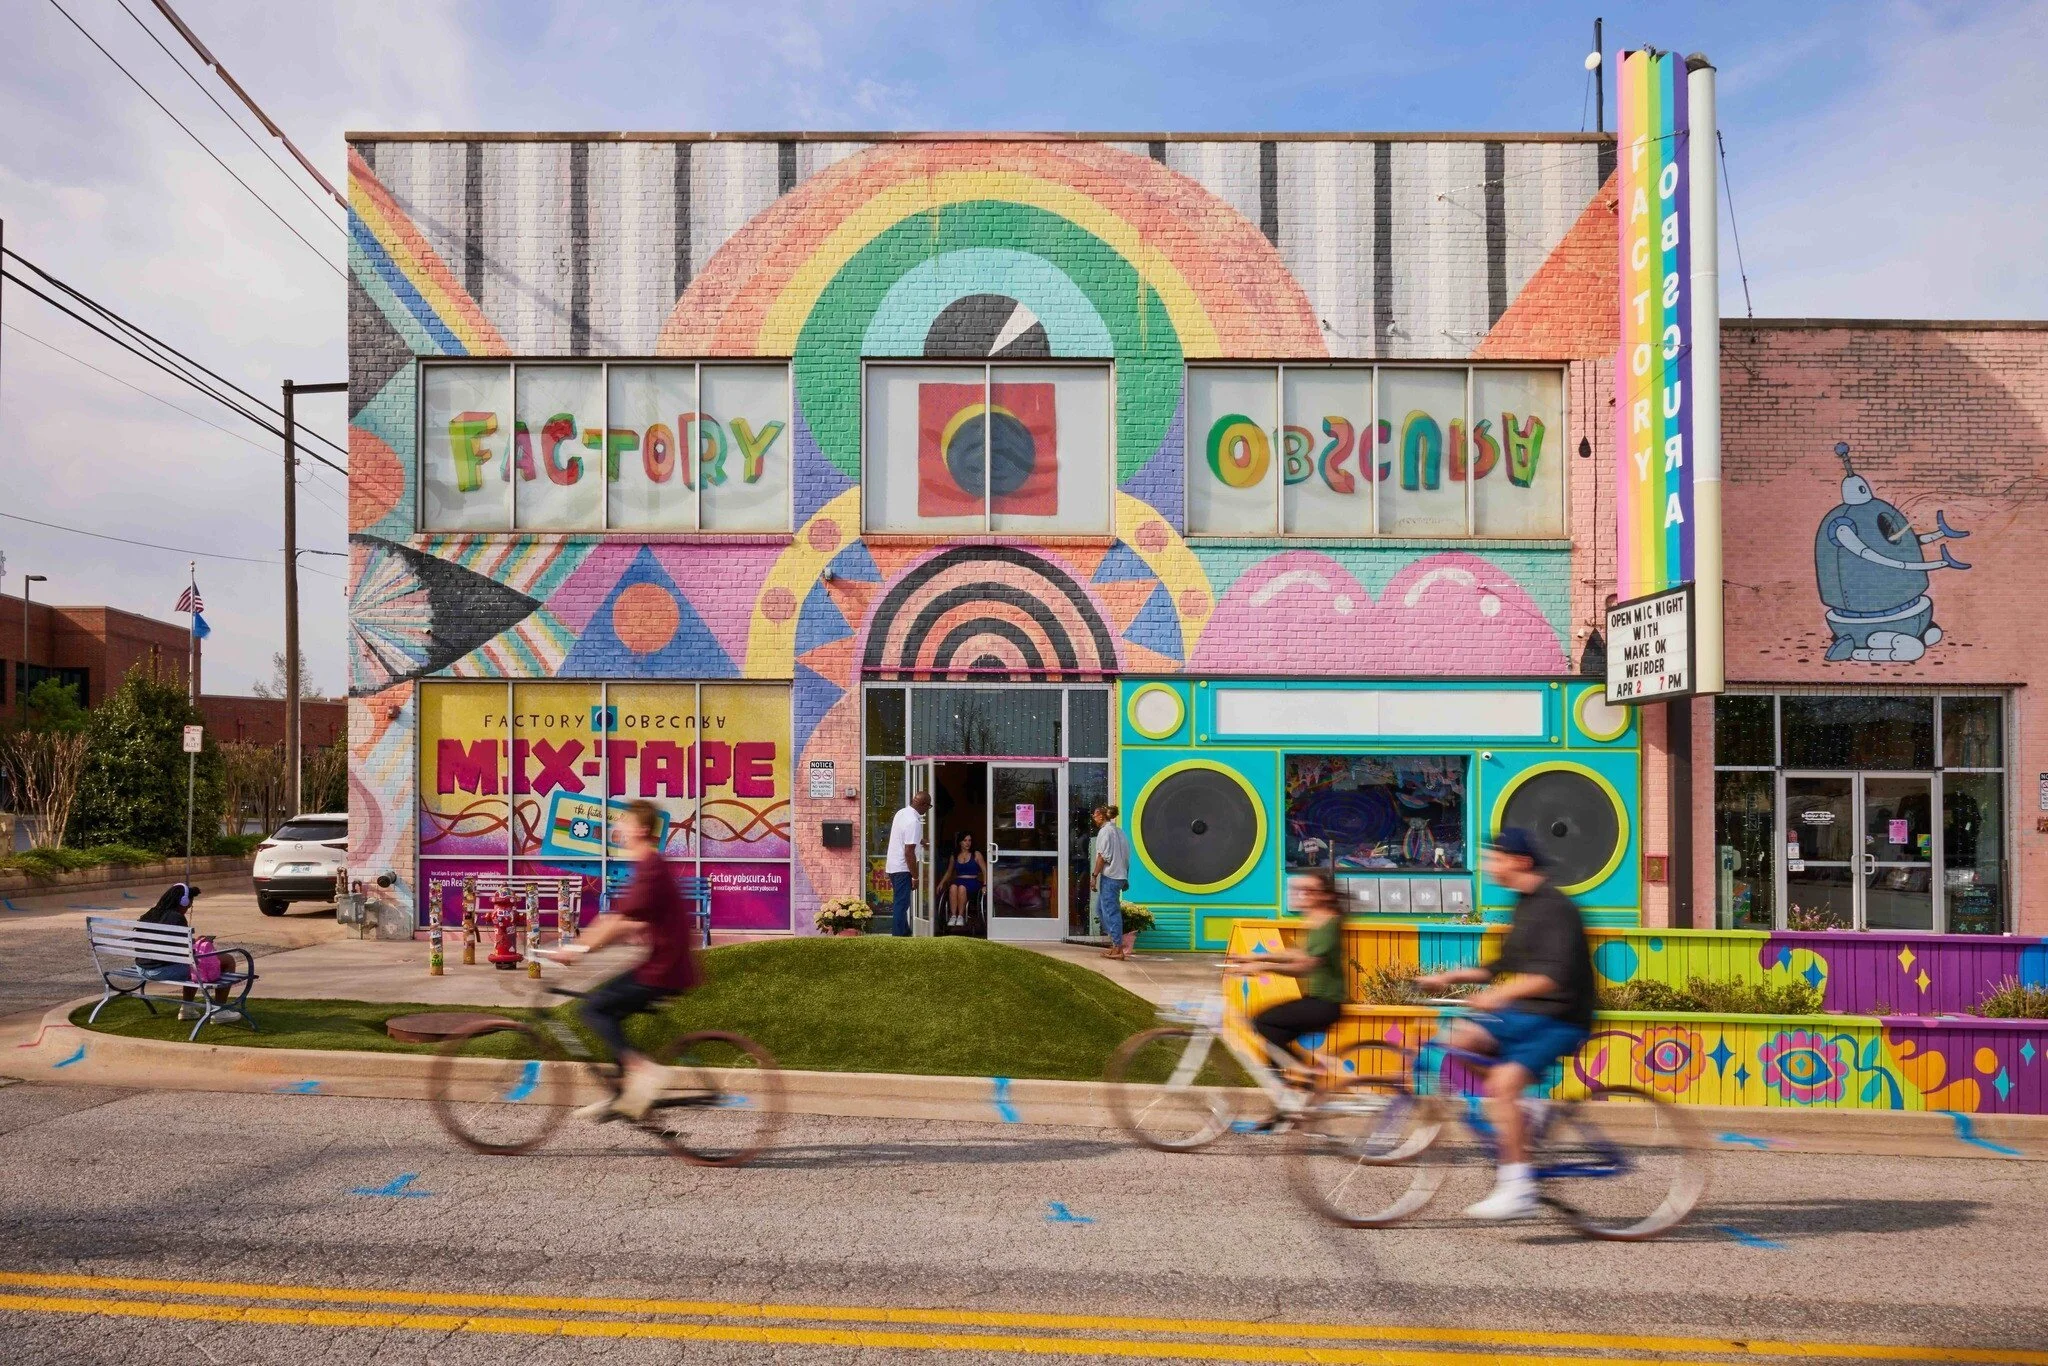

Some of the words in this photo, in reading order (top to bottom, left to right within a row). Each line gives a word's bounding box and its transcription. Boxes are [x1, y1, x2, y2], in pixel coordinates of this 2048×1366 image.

[1631, 133, 1652, 482] FACTORY
[448, 411, 786, 493] FACTORY
[1611, 611, 1632, 627] OPEN
[1634, 605, 1652, 622] MIC
[1656, 597, 1683, 616] NIGHT
[1633, 622, 1659, 640] WITH
[1624, 643, 1649, 661] MAKE
[1655, 639, 1667, 655] OK
[1626, 658, 1665, 678] WEIRDER
[1617, 684, 1633, 697] APR
[1636, 680, 1642, 693] 2
[1659, 676, 1665, 690] 7
[1668, 673, 1681, 688] PM
[484, 714, 585, 728] FACTORY
[437, 738, 776, 799] MIX-TAPE
[709, 872, 782, 885] factoryobscura.fun
